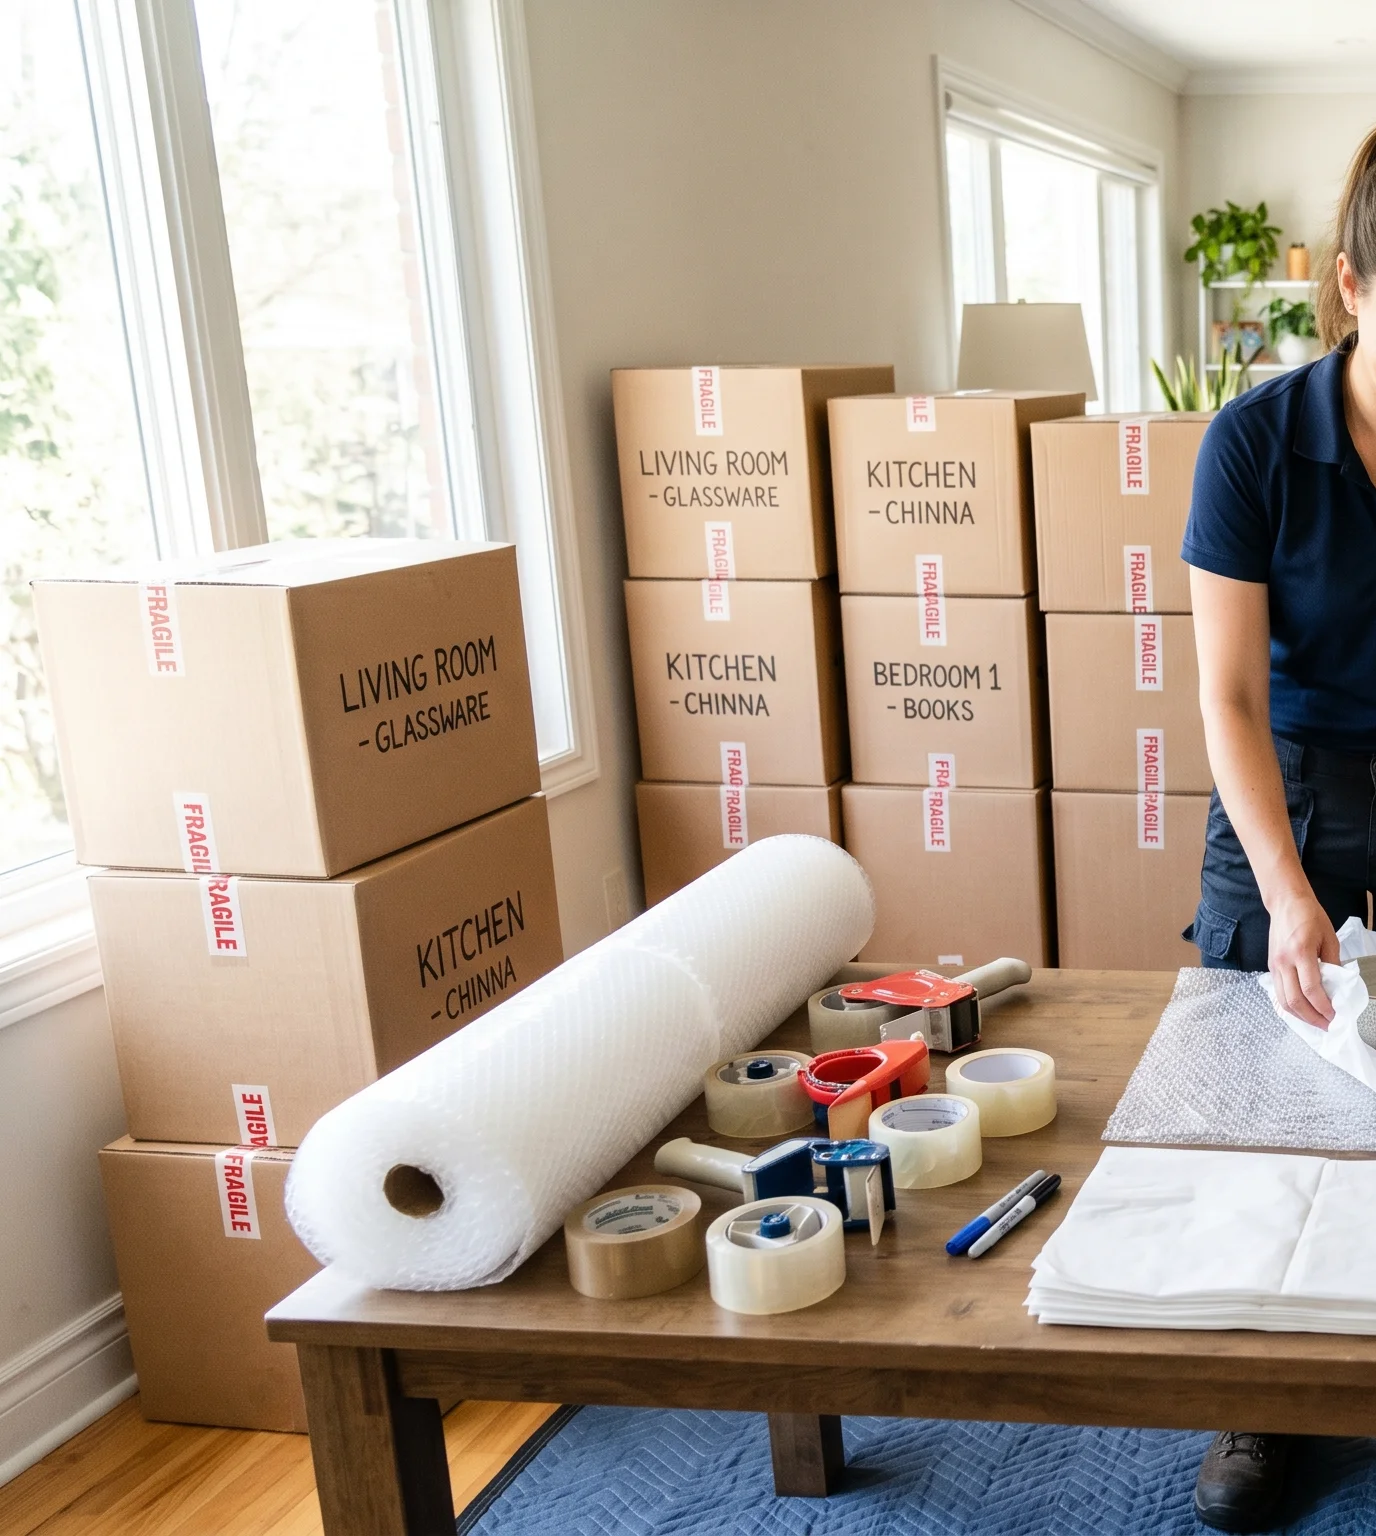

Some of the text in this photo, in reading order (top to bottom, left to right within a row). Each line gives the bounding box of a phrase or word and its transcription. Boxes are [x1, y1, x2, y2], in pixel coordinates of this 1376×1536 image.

[699, 369, 716, 427] FRAGILE
[640, 451, 788, 475] LIVING ROOM
[868, 461, 975, 488] KITCHEN
[1126, 425, 1142, 488] FRAGILE
[707, 581, 725, 612] GILE
[1131, 552, 1147, 612] FRAGILE
[148, 586, 176, 670] FRAGILE
[1142, 624, 1157, 683] FRAGILE
[340, 635, 496, 713] LIVING ROOM
[666, 653, 776, 681] KITCHEN
[874, 662, 1001, 690] BEDROOM 1
[904, 698, 973, 721] BOOKS
[208, 875, 238, 950] RAGILE
[416, 891, 524, 988] KITCHEN
[224, 1156, 250, 1231] FRAGILE
